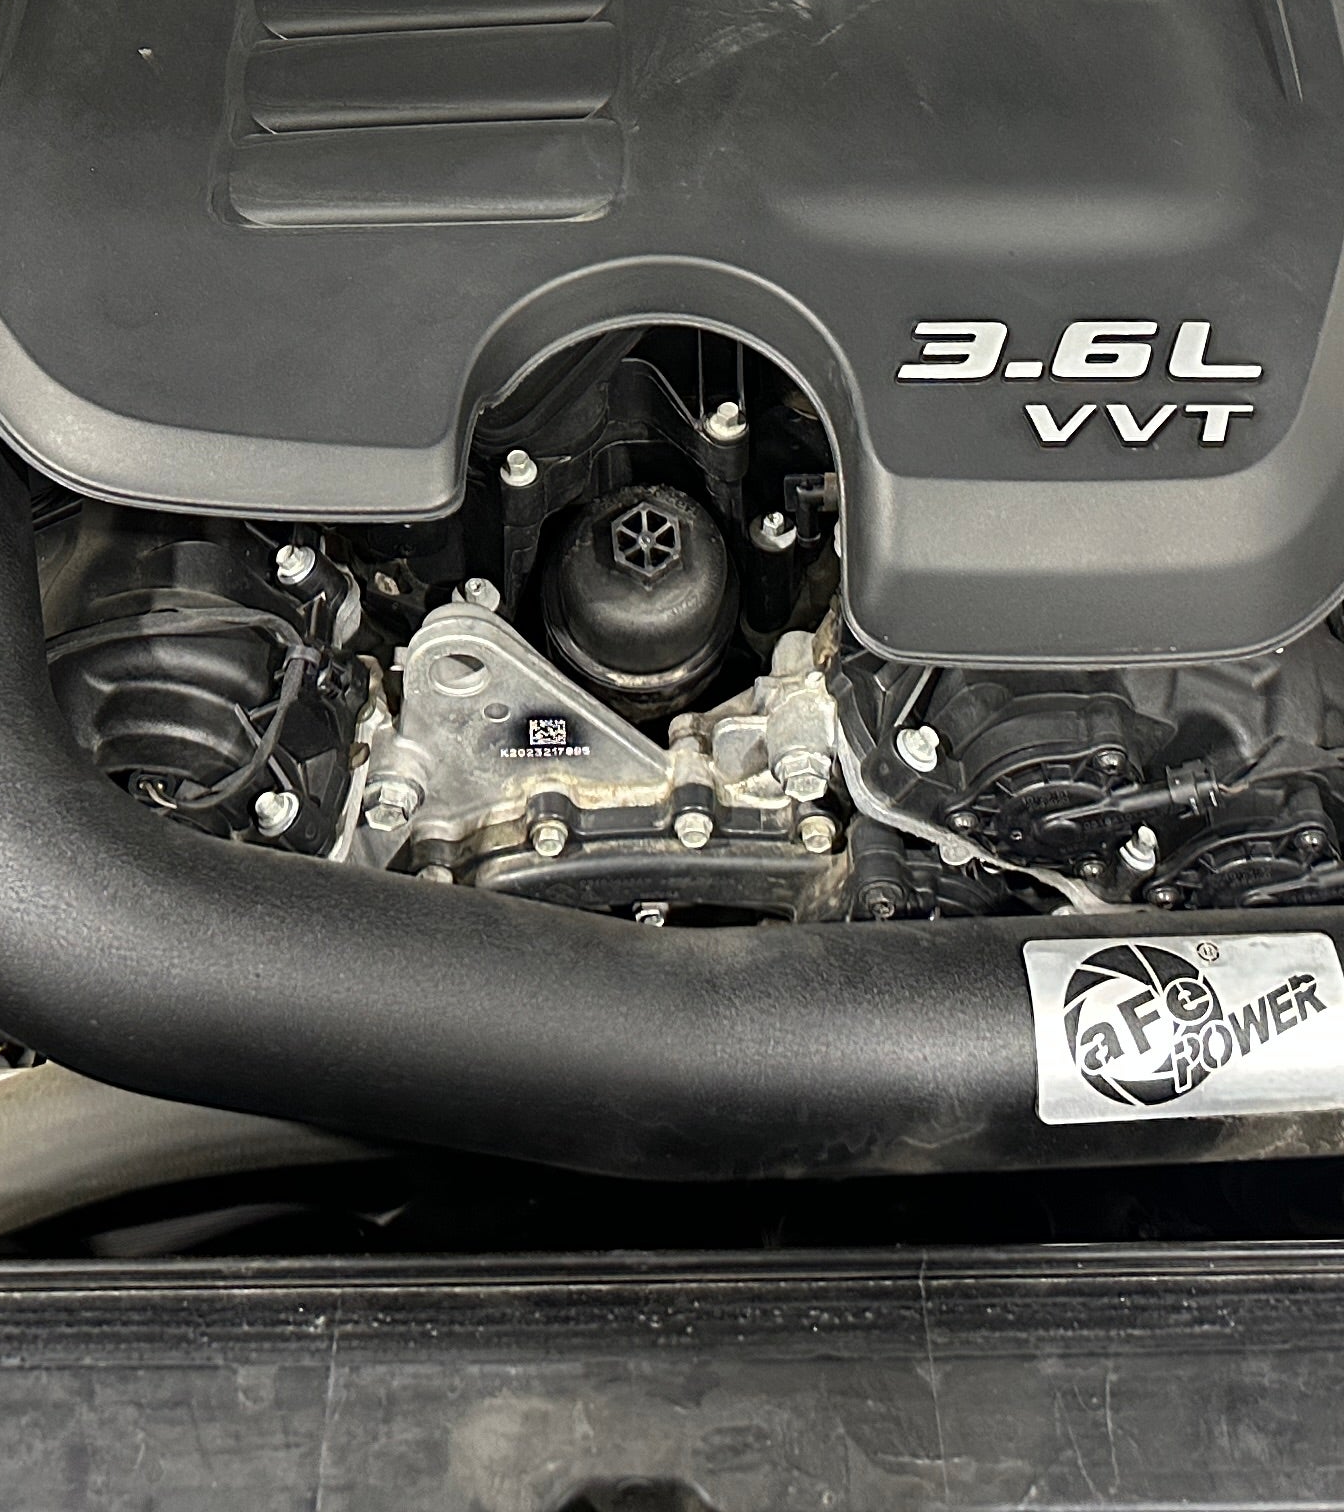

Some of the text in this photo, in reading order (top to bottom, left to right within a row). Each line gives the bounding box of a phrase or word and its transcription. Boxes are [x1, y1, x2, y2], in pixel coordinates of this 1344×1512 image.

[897, 321, 1262, 380] 3.6L
[1024, 403, 1254, 443] VVT
[1080, 979, 1212, 1072] aFe
[1172, 973, 1328, 1093] POWER
